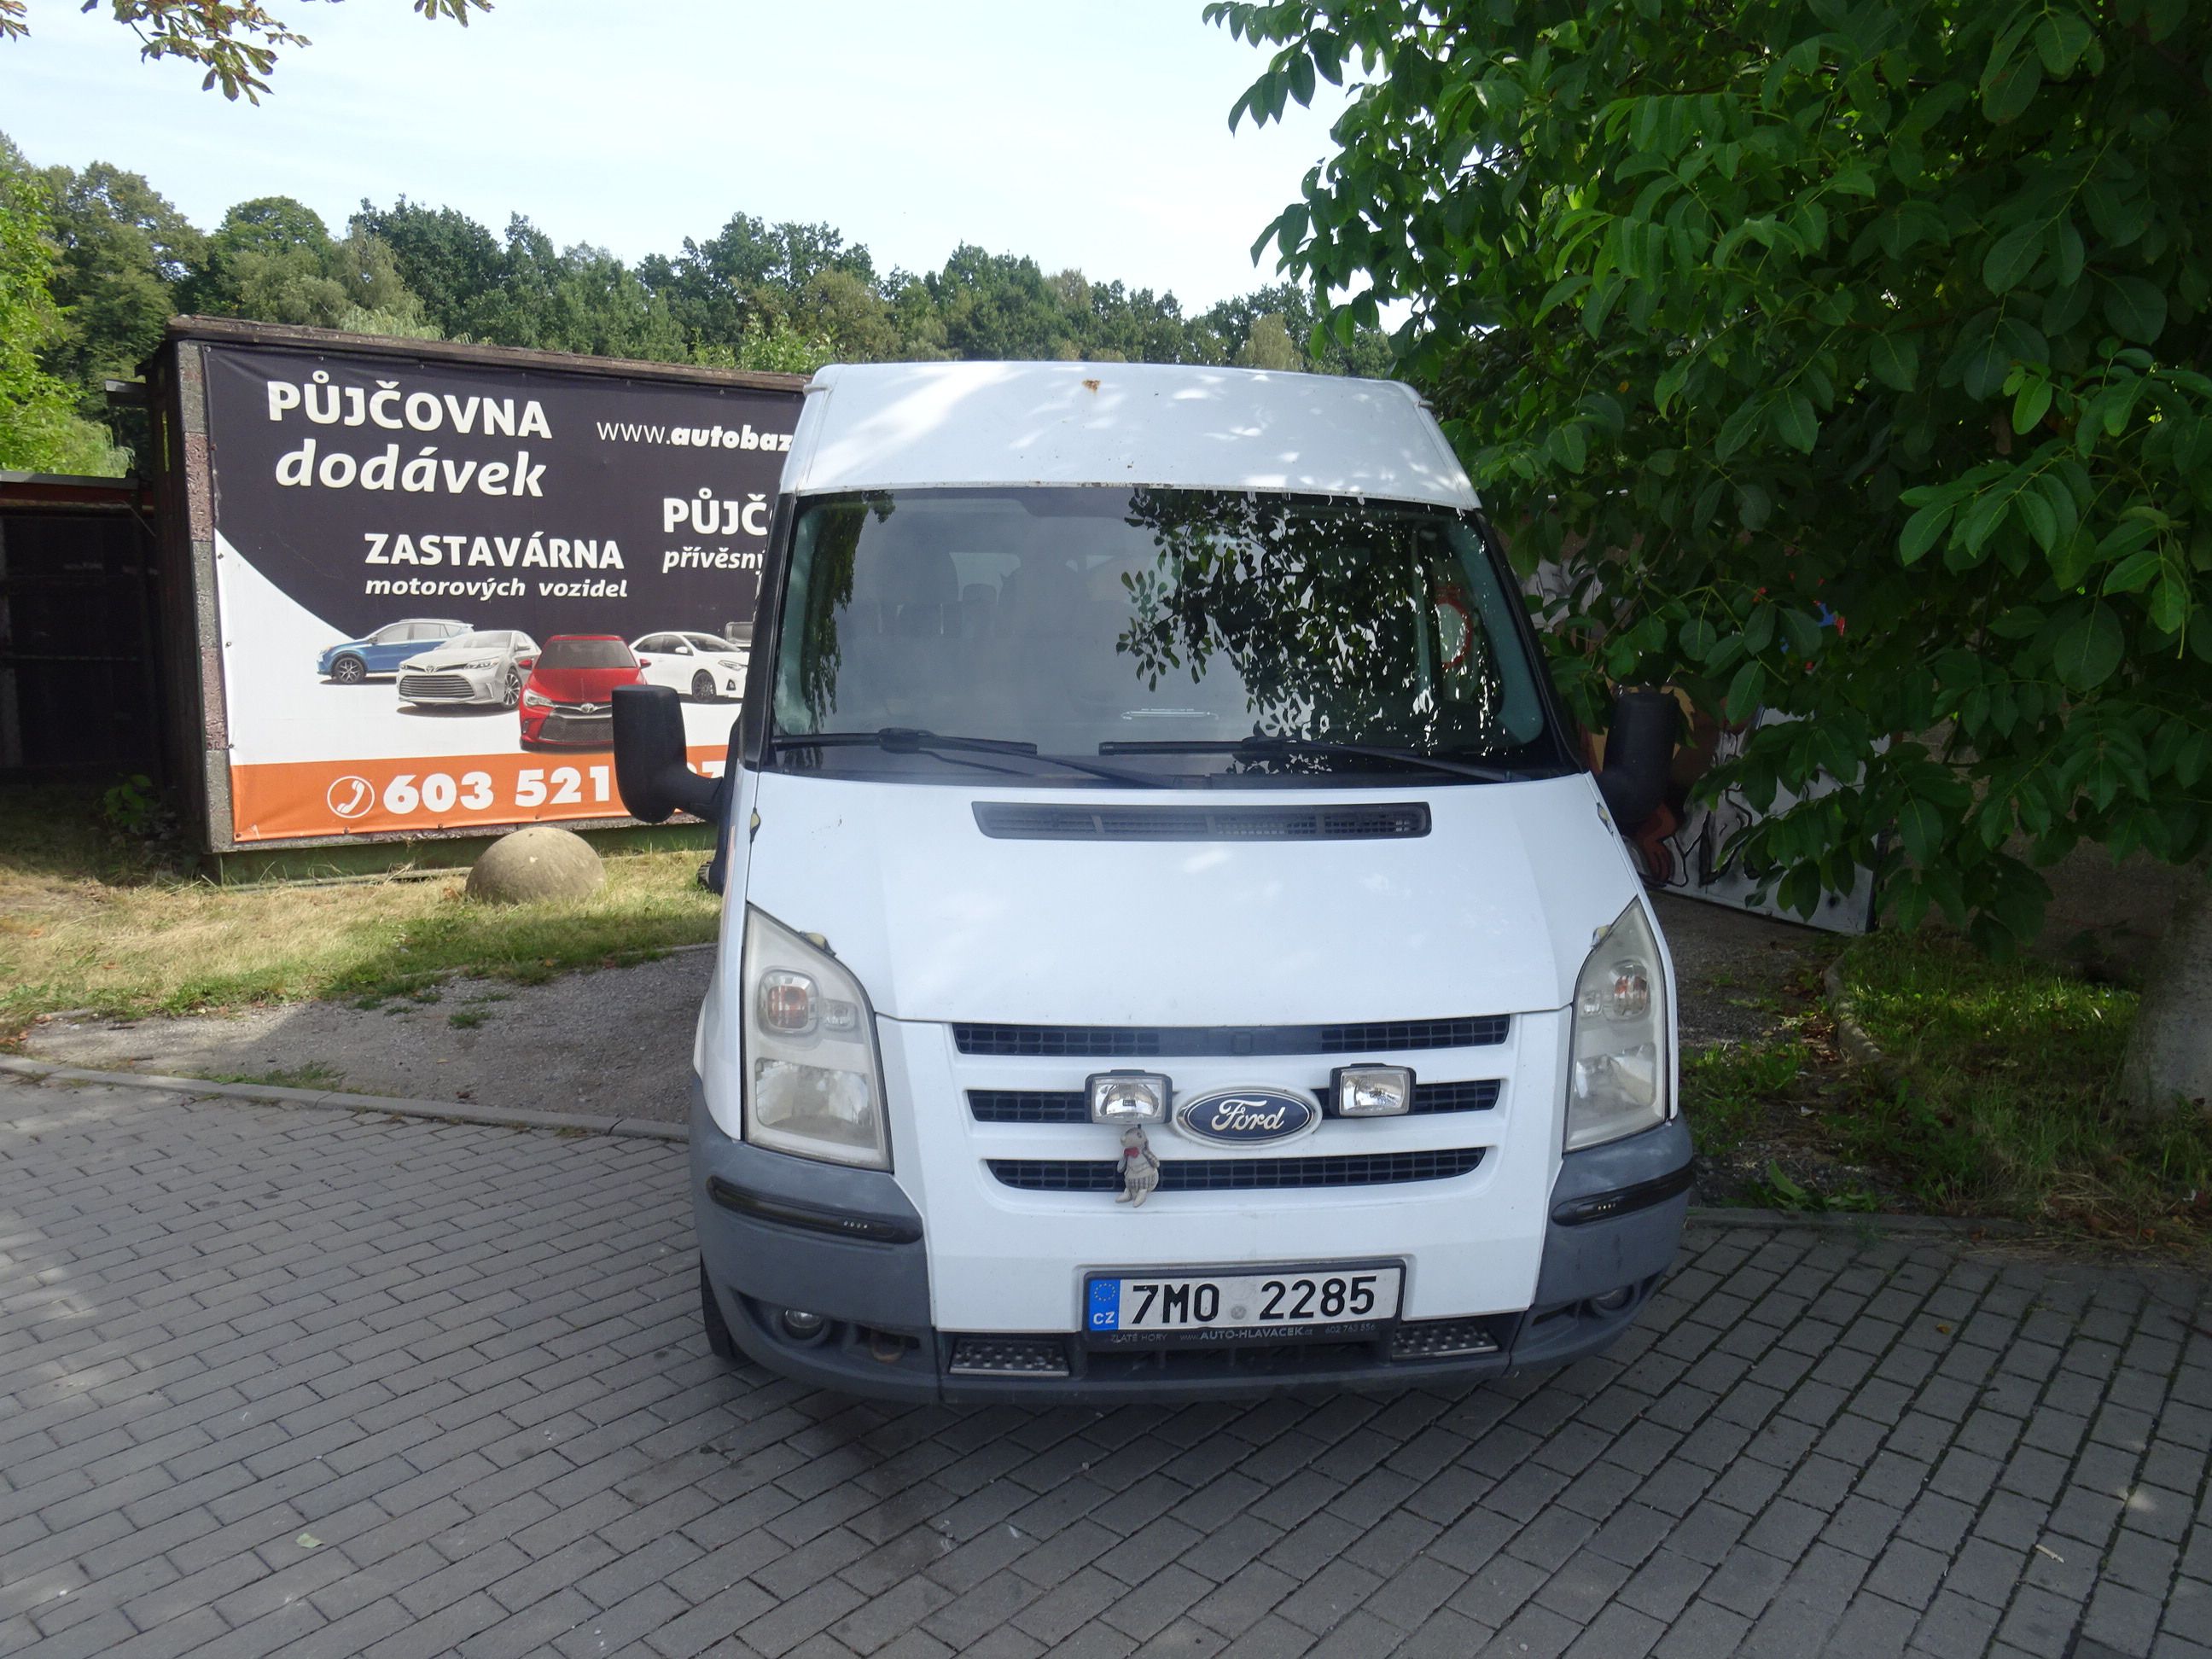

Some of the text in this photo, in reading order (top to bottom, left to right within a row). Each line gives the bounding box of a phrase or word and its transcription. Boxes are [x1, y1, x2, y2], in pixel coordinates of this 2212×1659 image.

[267, 370, 553, 439] PŮJČOVNA
[597, 422, 794, 451] www.autobaz
[275, 438, 547, 498] dodávek
[663, 487, 773, 536] PŮJČ
[364, 531, 625, 569] ZASTAVÁRNA
[364, 578, 628, 601] motorových vozidel
[382, 765, 610, 814] 603 521
[1211, 1099, 1286, 1132] Ford
[1093, 1312, 1115, 1324] CZ
[1259, 1276, 1376, 1320] 2285
